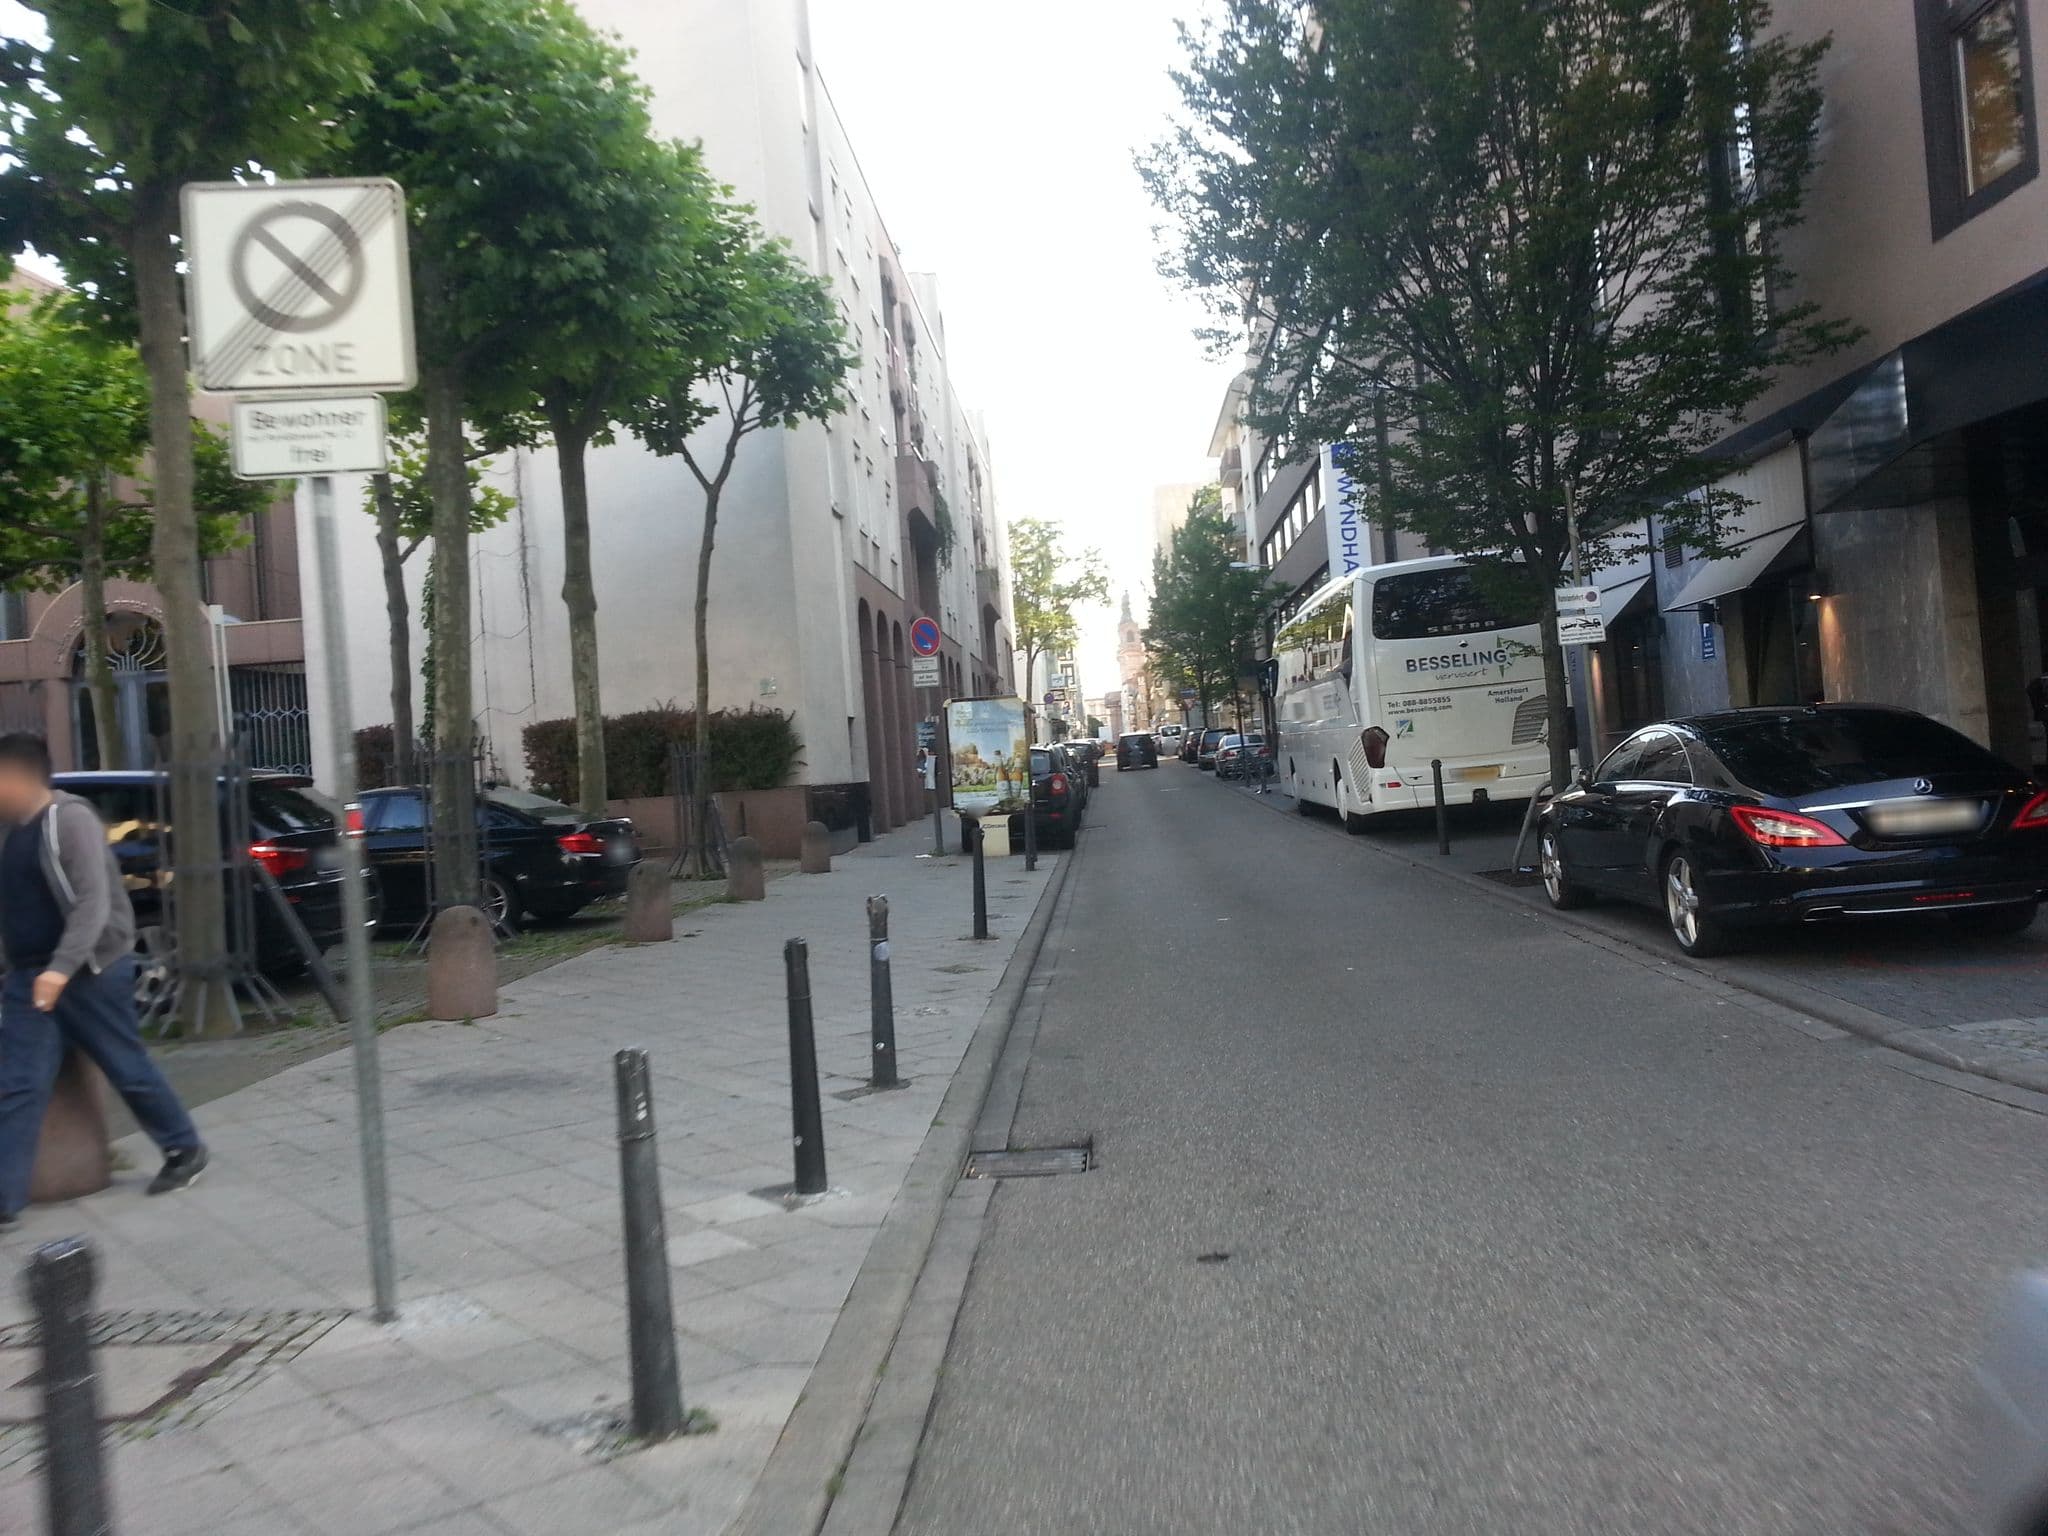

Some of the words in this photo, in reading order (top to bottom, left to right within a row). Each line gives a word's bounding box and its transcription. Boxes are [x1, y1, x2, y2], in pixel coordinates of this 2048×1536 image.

[252, 343, 357, 375] ZONE
[1337, 474, 1360, 577] WYNDHA
[1406, 649, 1507, 673] BESSELING
[1488, 687, 1529, 697] Amersfoort
[1388, 705, 1453, 716] www.besseling.com
